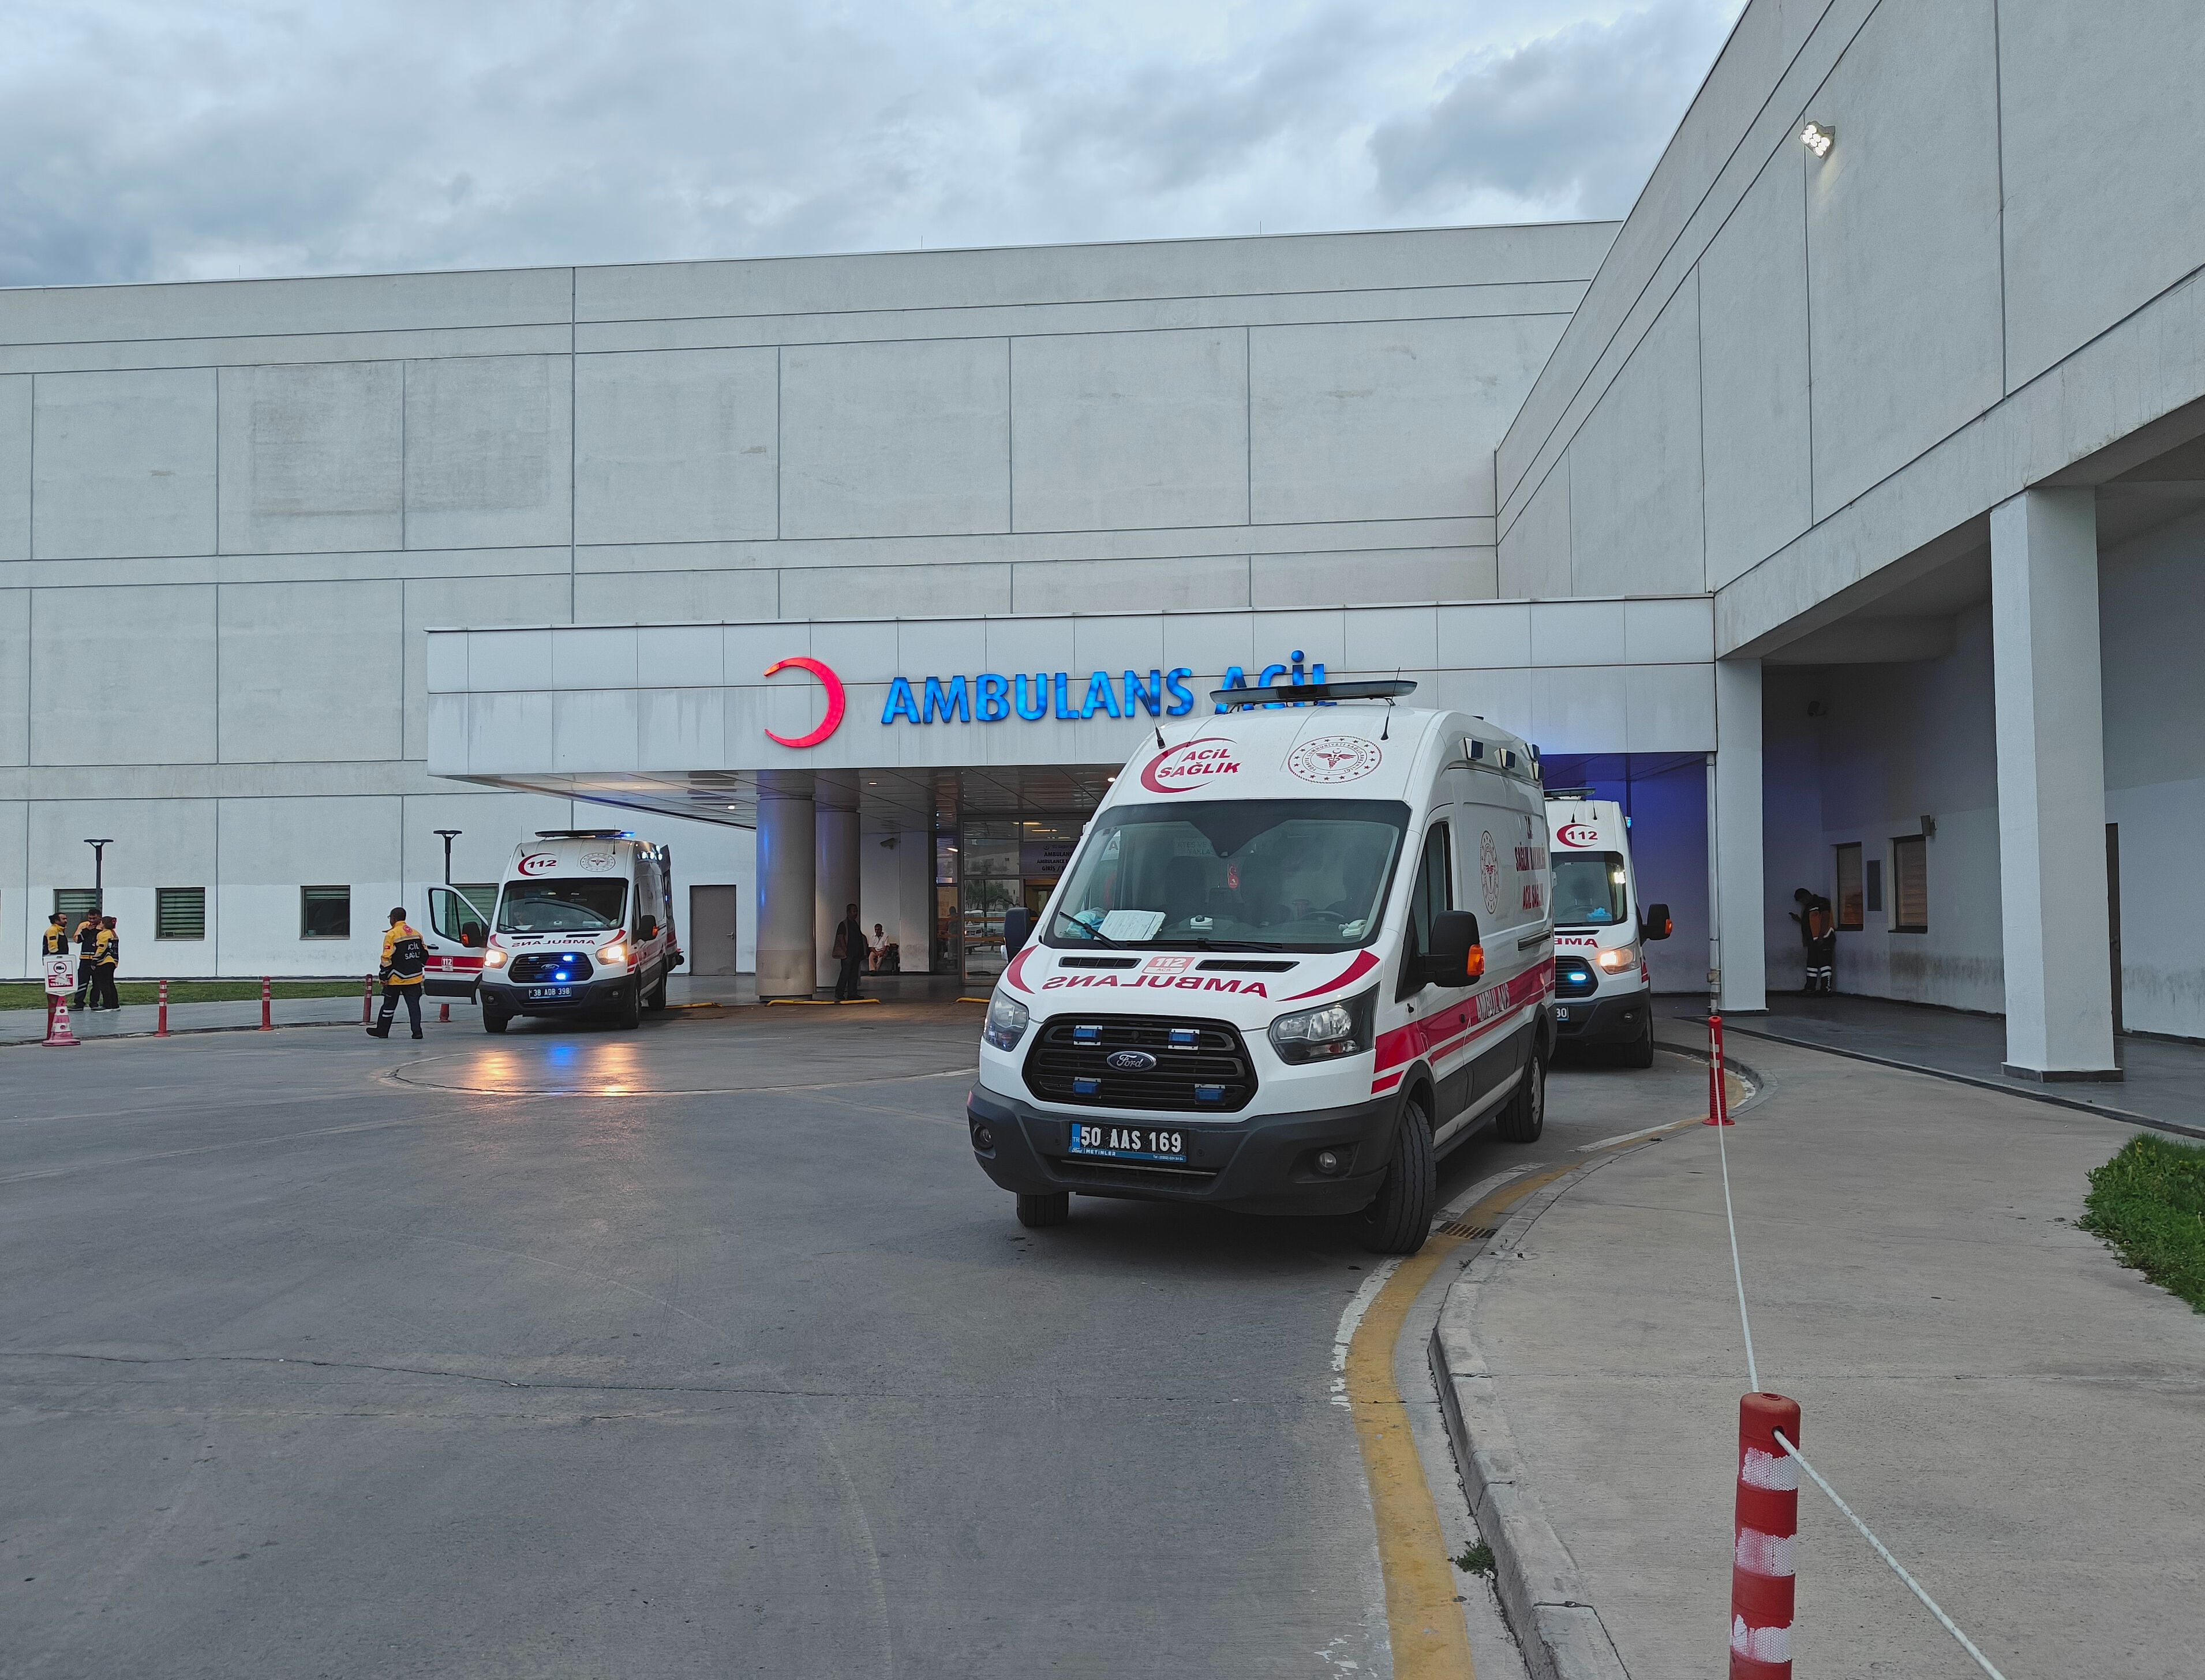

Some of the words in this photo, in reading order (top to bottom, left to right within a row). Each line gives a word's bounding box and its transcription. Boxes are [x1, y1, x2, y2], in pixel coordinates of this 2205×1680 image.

[881, 667, 1194, 724] AMBULANS
[1215, 650, 1337, 715] ACİL
[1181, 748, 1231, 763] ACİL
[1157, 762, 1241, 778] SAĞLIK
[1567, 831, 1598, 840] 112
[527, 860, 557, 868] 112
[1155, 958, 1186, 967] 112
[1116, 1054, 1144, 1068] Ford
[1081, 1127, 1102, 1146] 50
[1110, 1128, 1141, 1150] AAS
[1149, 1132, 1181, 1153] 169
